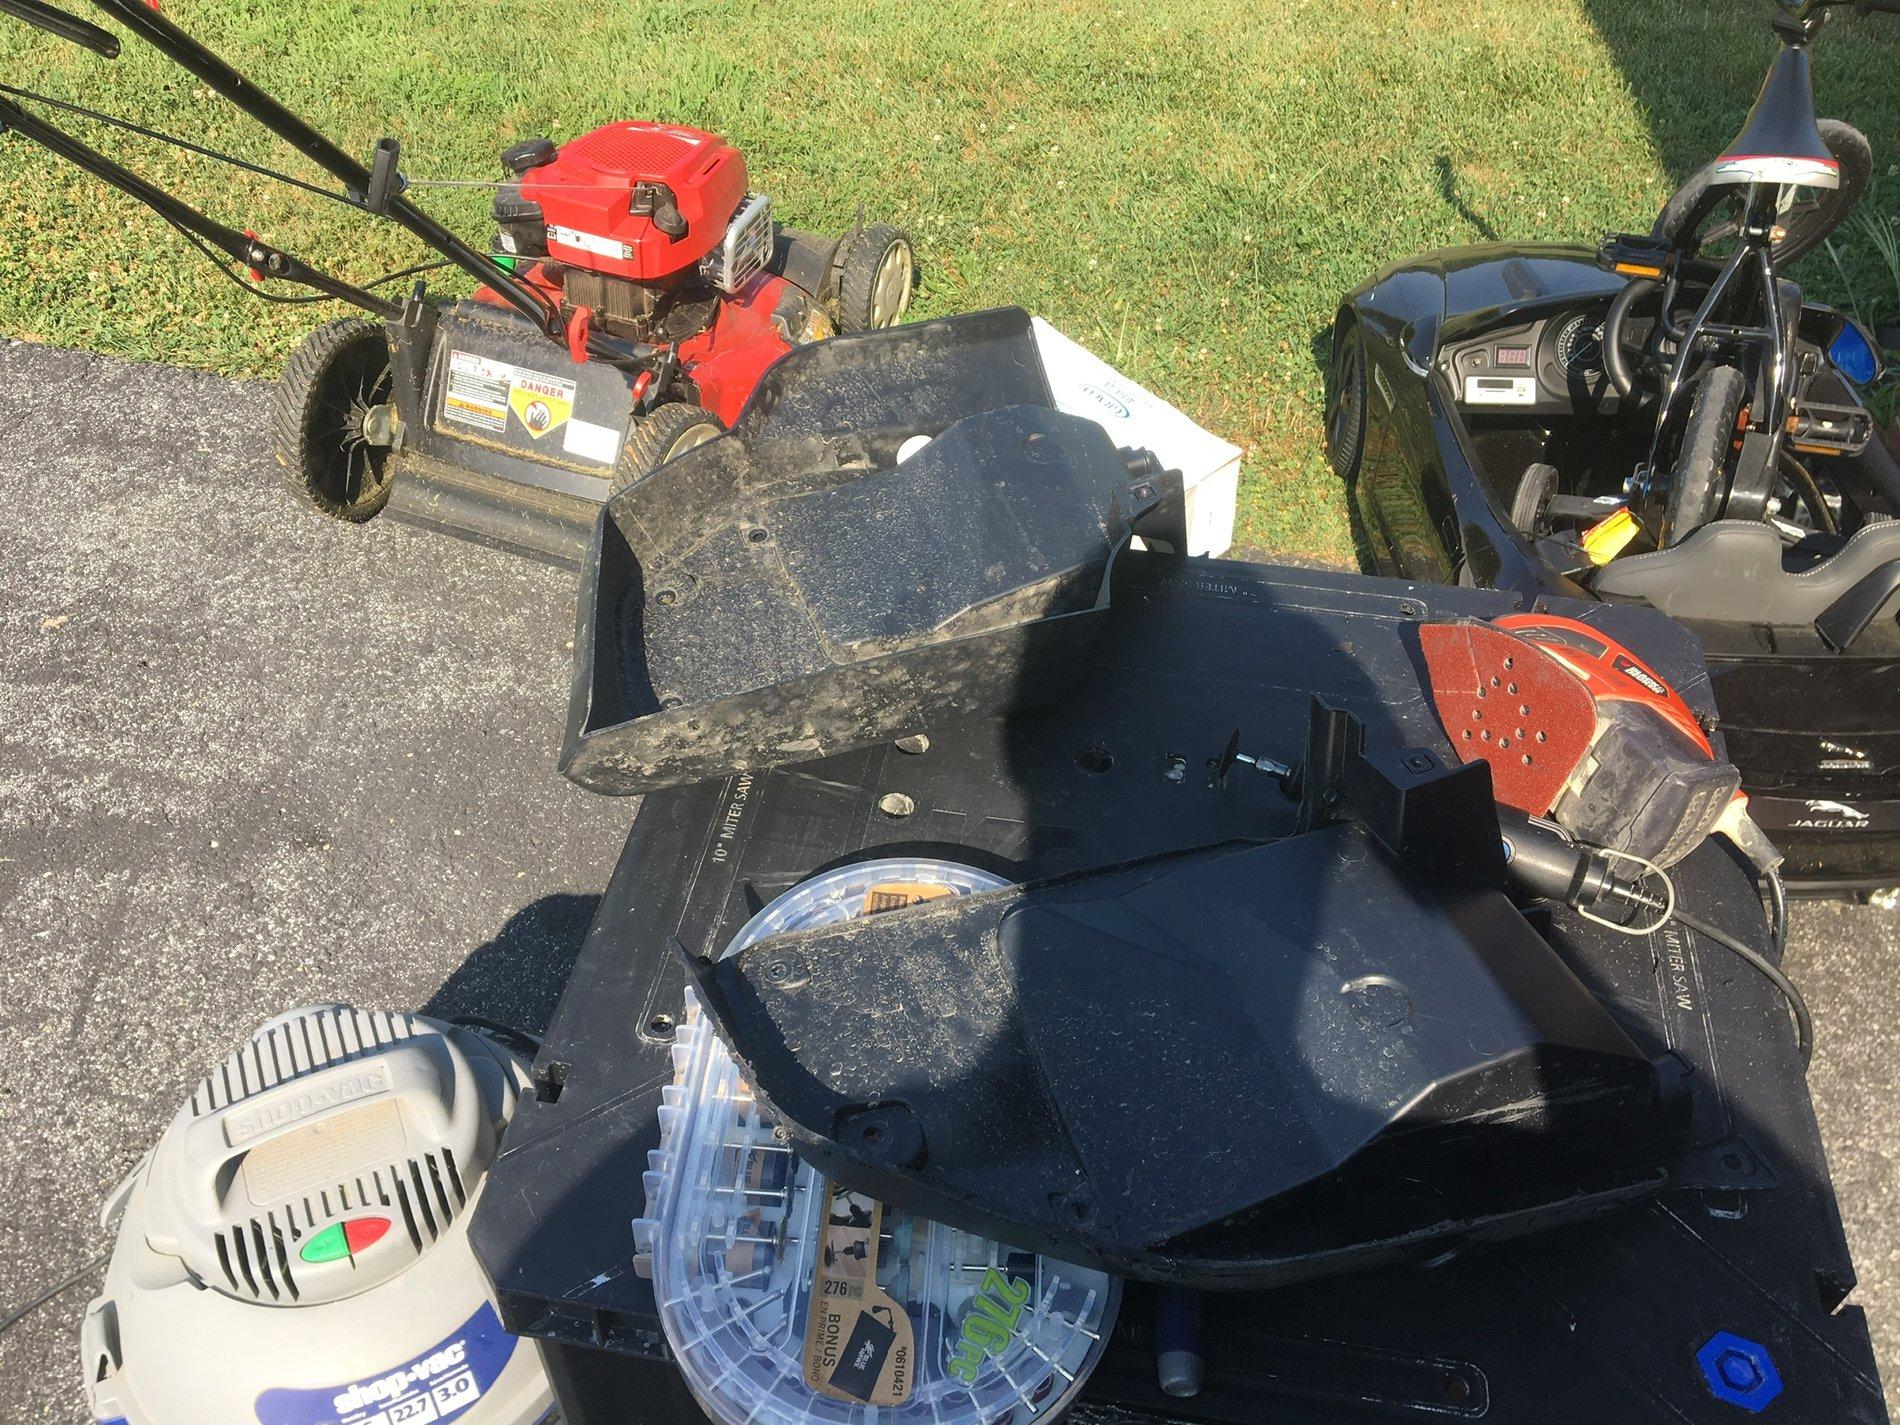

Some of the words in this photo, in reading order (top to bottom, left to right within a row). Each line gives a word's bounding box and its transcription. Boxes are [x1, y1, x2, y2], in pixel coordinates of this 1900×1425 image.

[520, 379, 564, 398] DANGER
[720, 803, 745, 839] MITER
[734, 773, 754, 801] SAW
[1788, 819, 1870, 828] JAGUAR
[1664, 930, 1685, 972] MITER
[1672, 975, 1692, 1011] SAW
[824, 1280, 848, 1297] 276
[820, 1301, 829, 1314] EN
[815, 1316, 827, 1346] PRIME
[822, 1313, 841, 1367] BONUS
[810, 1354, 822, 1382] BONO
[393, 1397, 426, 1423] 22.7
[437, 1377, 470, 1403] 3.0
